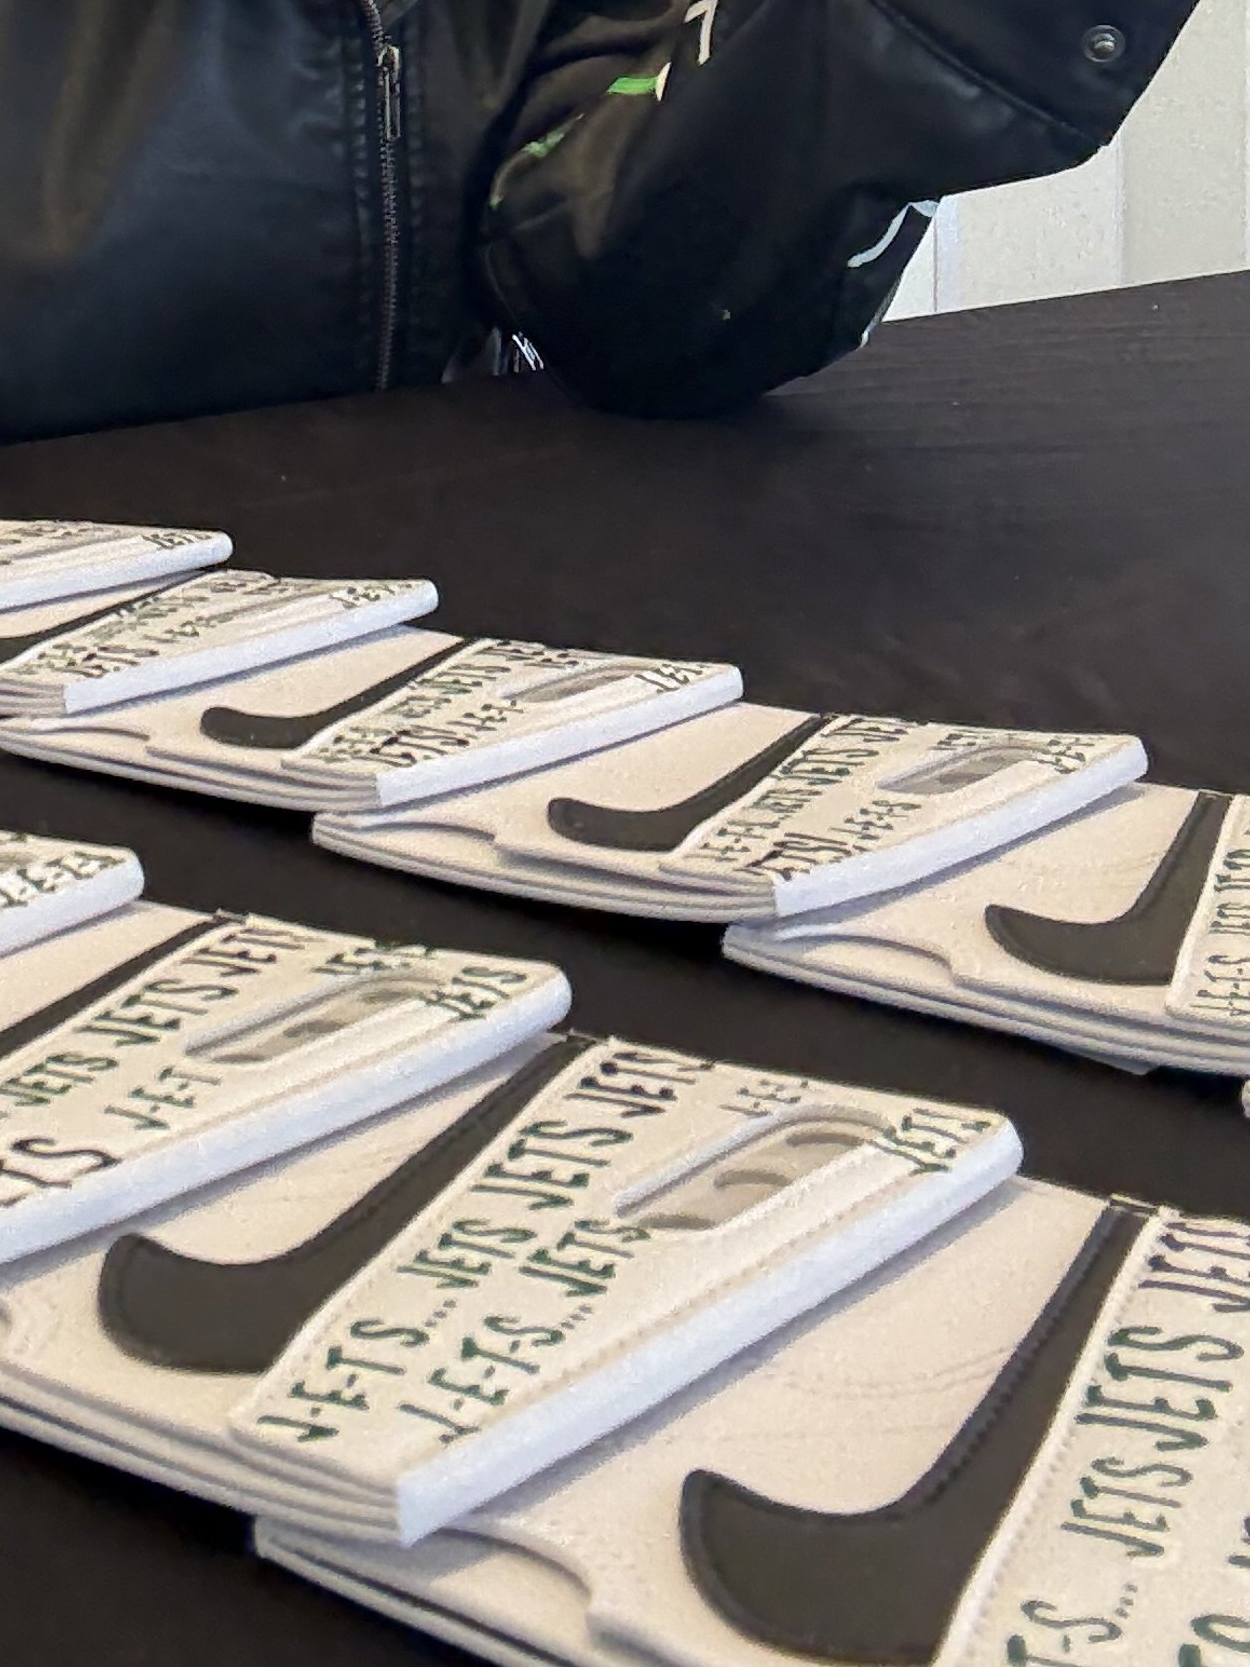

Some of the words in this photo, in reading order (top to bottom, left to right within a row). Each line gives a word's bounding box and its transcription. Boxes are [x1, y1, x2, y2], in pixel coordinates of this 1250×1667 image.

[72, 978, 241, 1047] JETS
[396, 1218, 539, 1288] JETS
[471, 1119, 634, 1211] JETS
[518, 1218, 652, 1297] JETS
[1074, 1325, 1246, 1452] JETS
[1059, 1455, 1194, 1557] JETS
